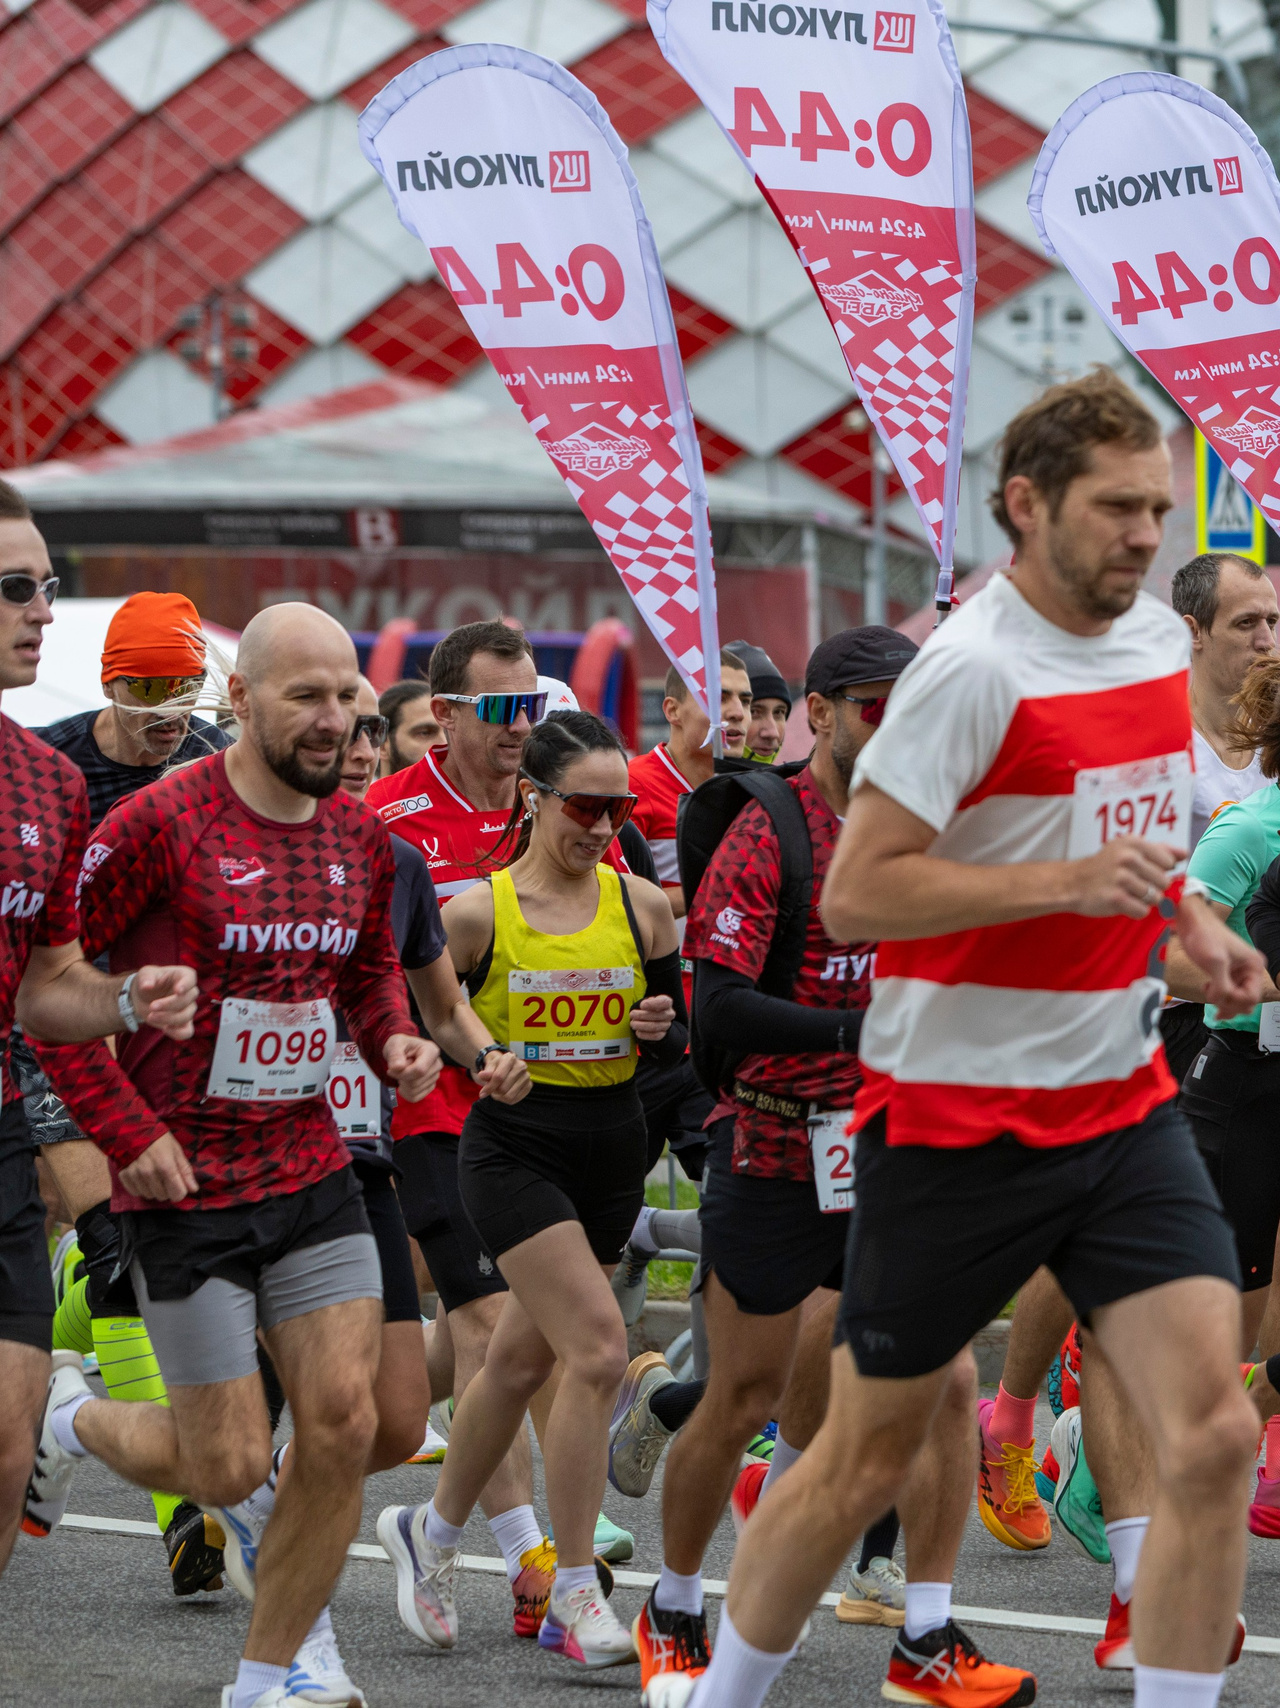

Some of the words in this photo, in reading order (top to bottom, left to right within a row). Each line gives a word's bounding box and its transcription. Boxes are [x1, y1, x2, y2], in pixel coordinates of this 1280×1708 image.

[258, 568, 638, 633] УКОЙЛ
[400, 797, 430, 813] 100
[1095, 789, 1178, 843] 1974
[427, 859, 452, 869] ÖGEL
[724, 910, 742, 932] 35
[218, 917, 359, 956] ЛУКОЙЛ
[521, 977, 531, 985] 10
[522, 993, 625, 1028] 2070
[236, 1027, 327, 1066] 1098
[556, 1030, 597, 1038] ЕЛИЗАВЕТА
[329, 1075, 367, 1110] 01
[109, 1321, 145, 1331] CE
